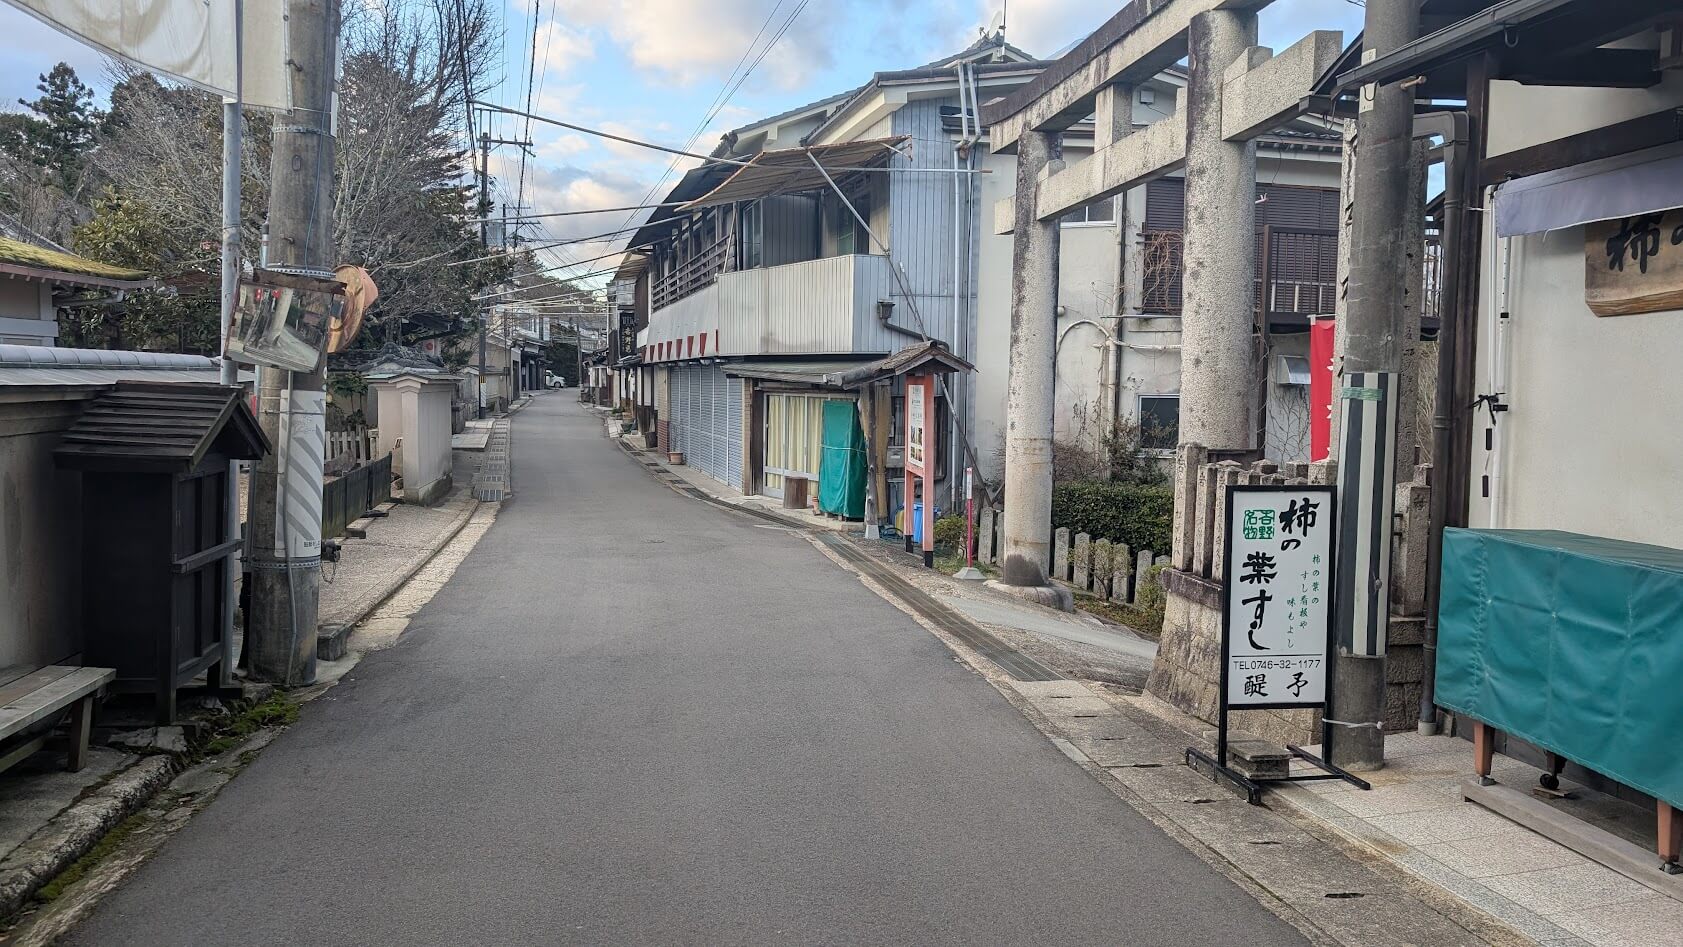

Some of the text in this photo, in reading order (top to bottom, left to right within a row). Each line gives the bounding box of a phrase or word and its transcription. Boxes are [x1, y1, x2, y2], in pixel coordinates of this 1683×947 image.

[1606, 213, 1683, 274] 柿
[1279, 498, 1320, 550] 柿の
[1240, 551, 1278, 650] 葉すし
[1311, 554, 1320, 604] 柿の葉の
